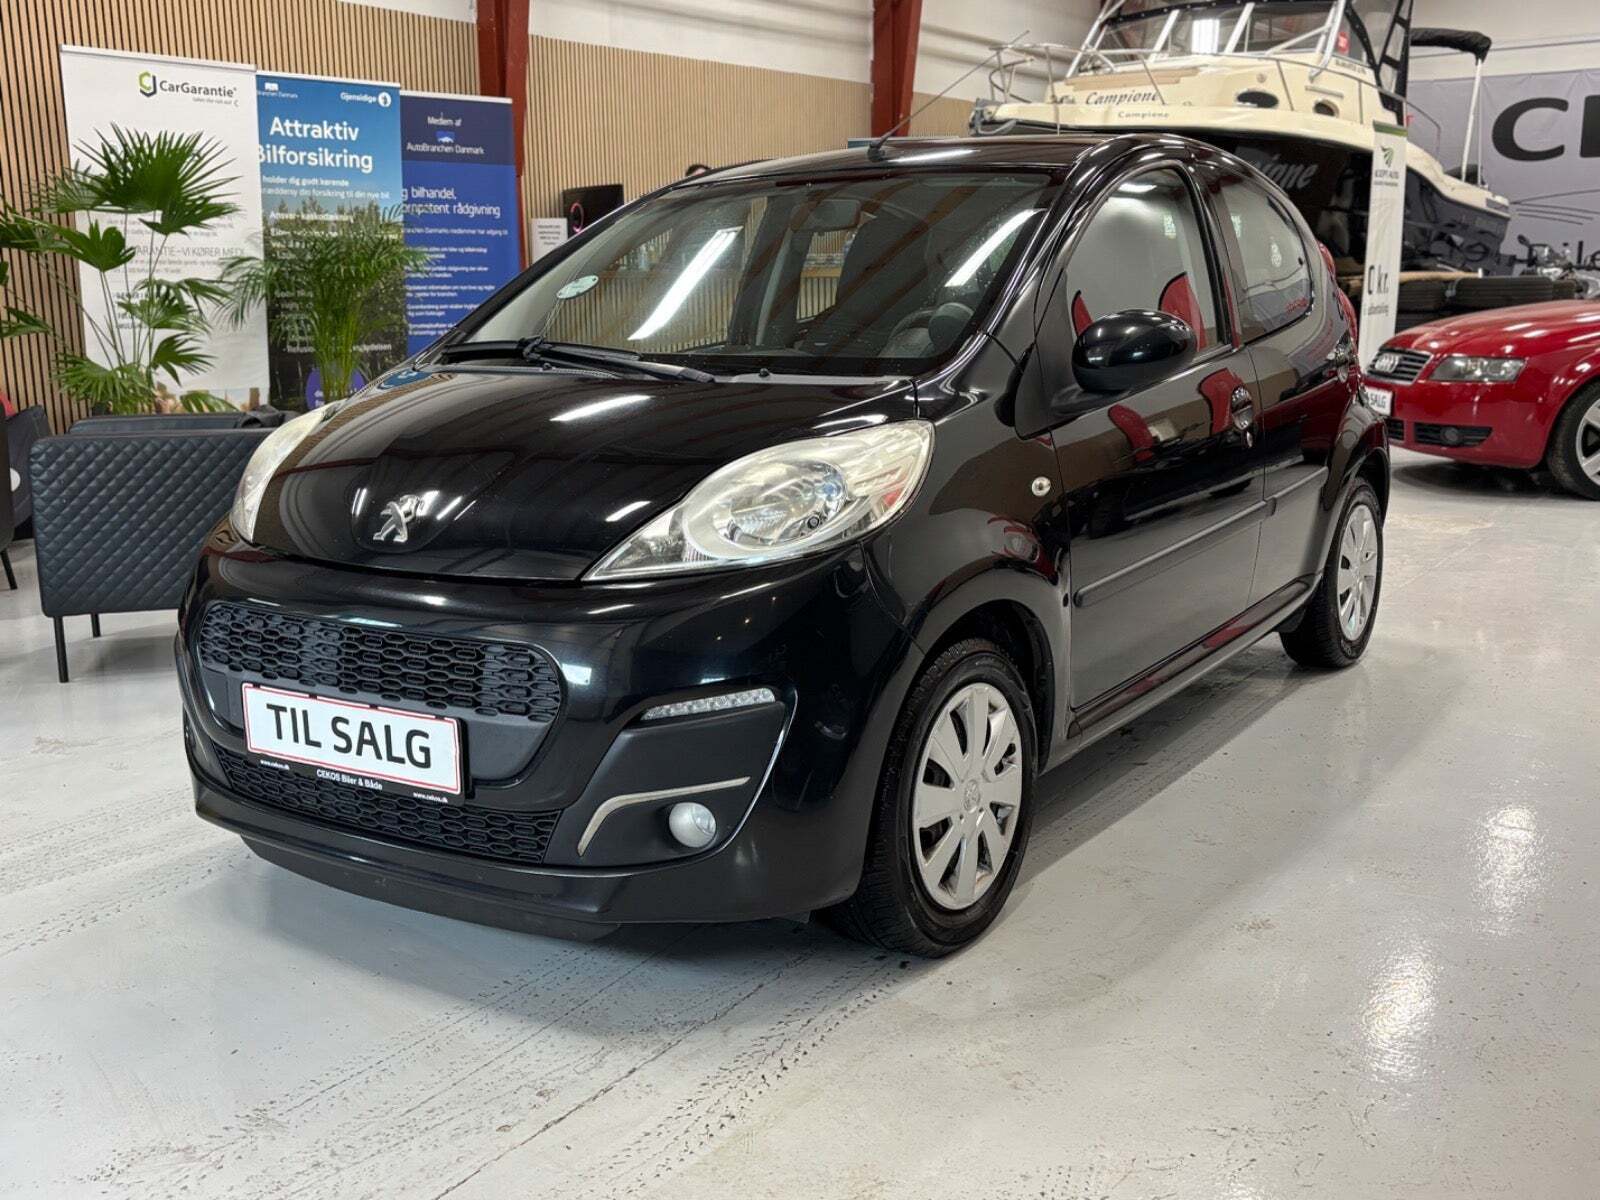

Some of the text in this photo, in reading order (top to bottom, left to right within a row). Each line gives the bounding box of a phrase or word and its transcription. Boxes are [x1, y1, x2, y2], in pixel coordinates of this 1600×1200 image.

[270, 116, 359, 141] Attraktiv
[452, 202, 501, 219] rådgivning
[266, 703, 431, 769] TIL SALG
[316, 769, 340, 782] CEKOS
[341, 774, 357, 785] Biler
[364, 779, 383, 790] Både
